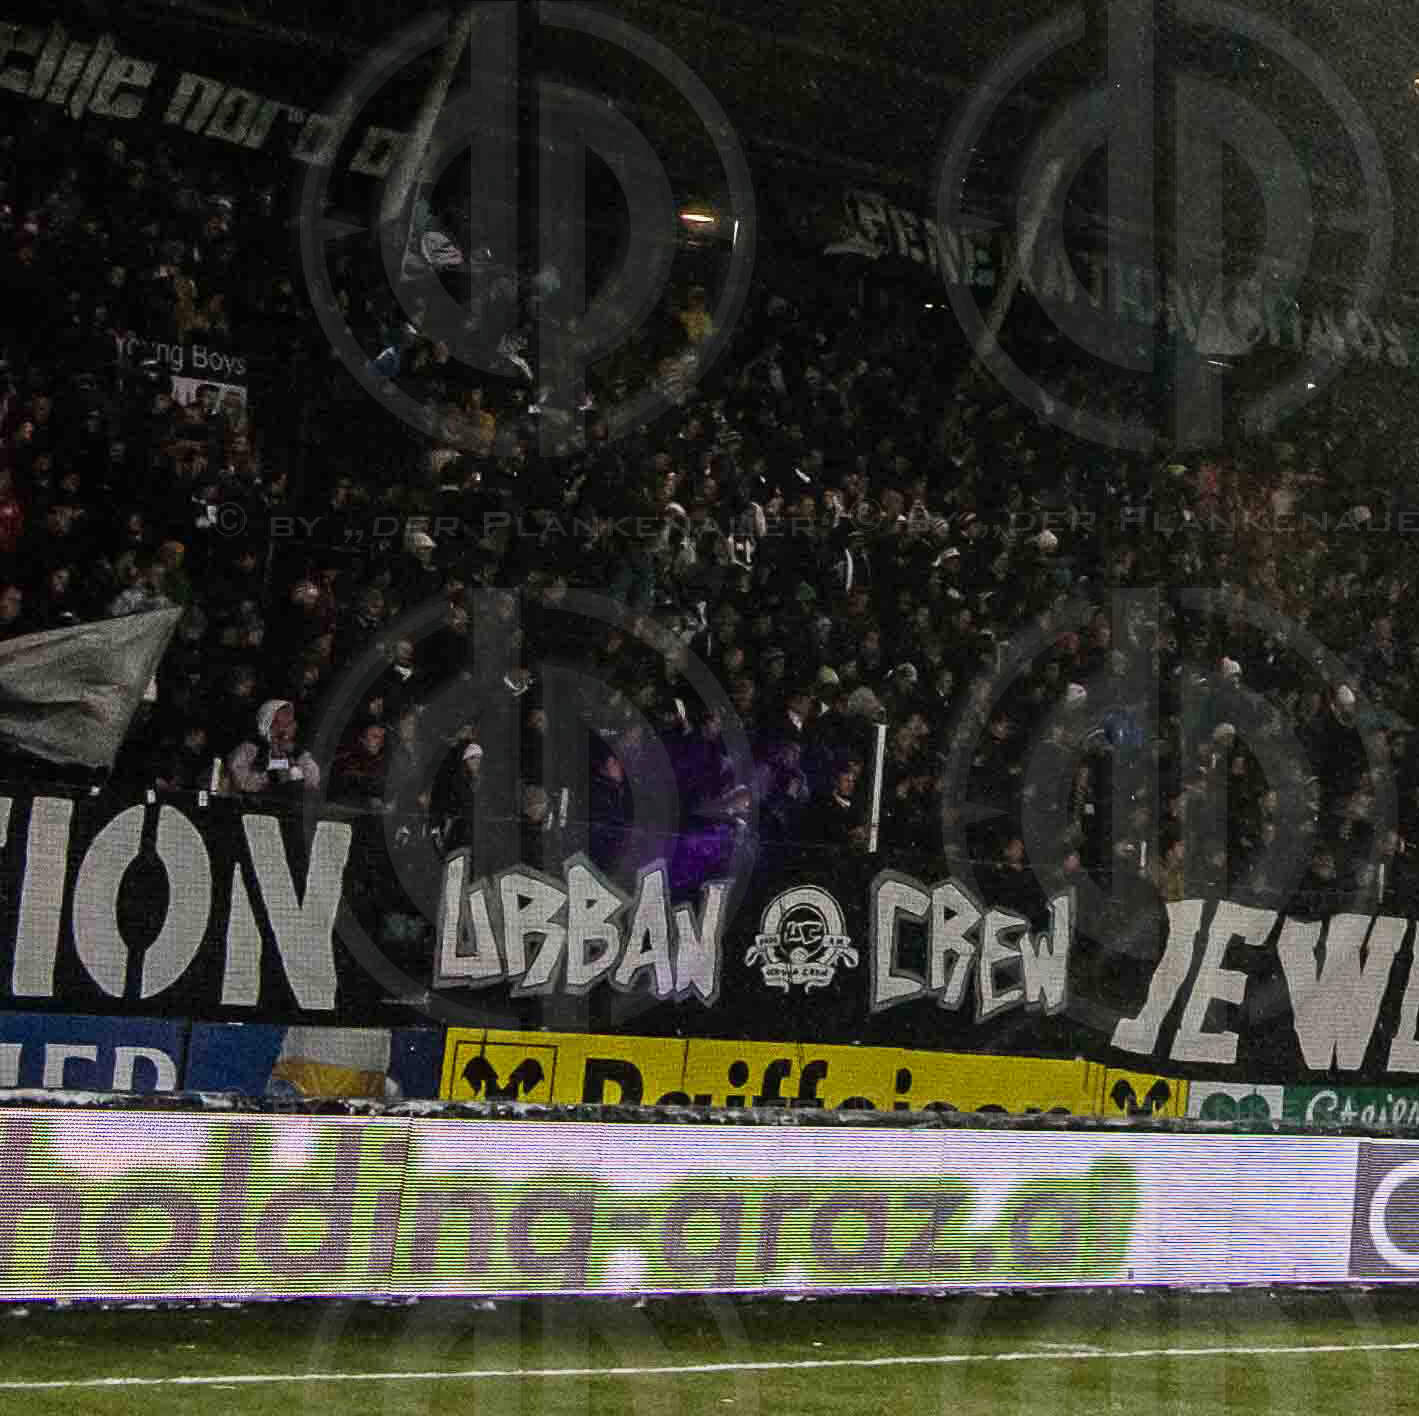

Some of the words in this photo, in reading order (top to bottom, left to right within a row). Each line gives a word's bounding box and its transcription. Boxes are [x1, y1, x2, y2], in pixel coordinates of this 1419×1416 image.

[112, 330, 184, 373] Yng
[192, 344, 247, 378] Boys
[0, 794, 353, 1012] ION
[436, 851, 730, 1004] URBAN
[870, 869, 1078, 1024] CREW
